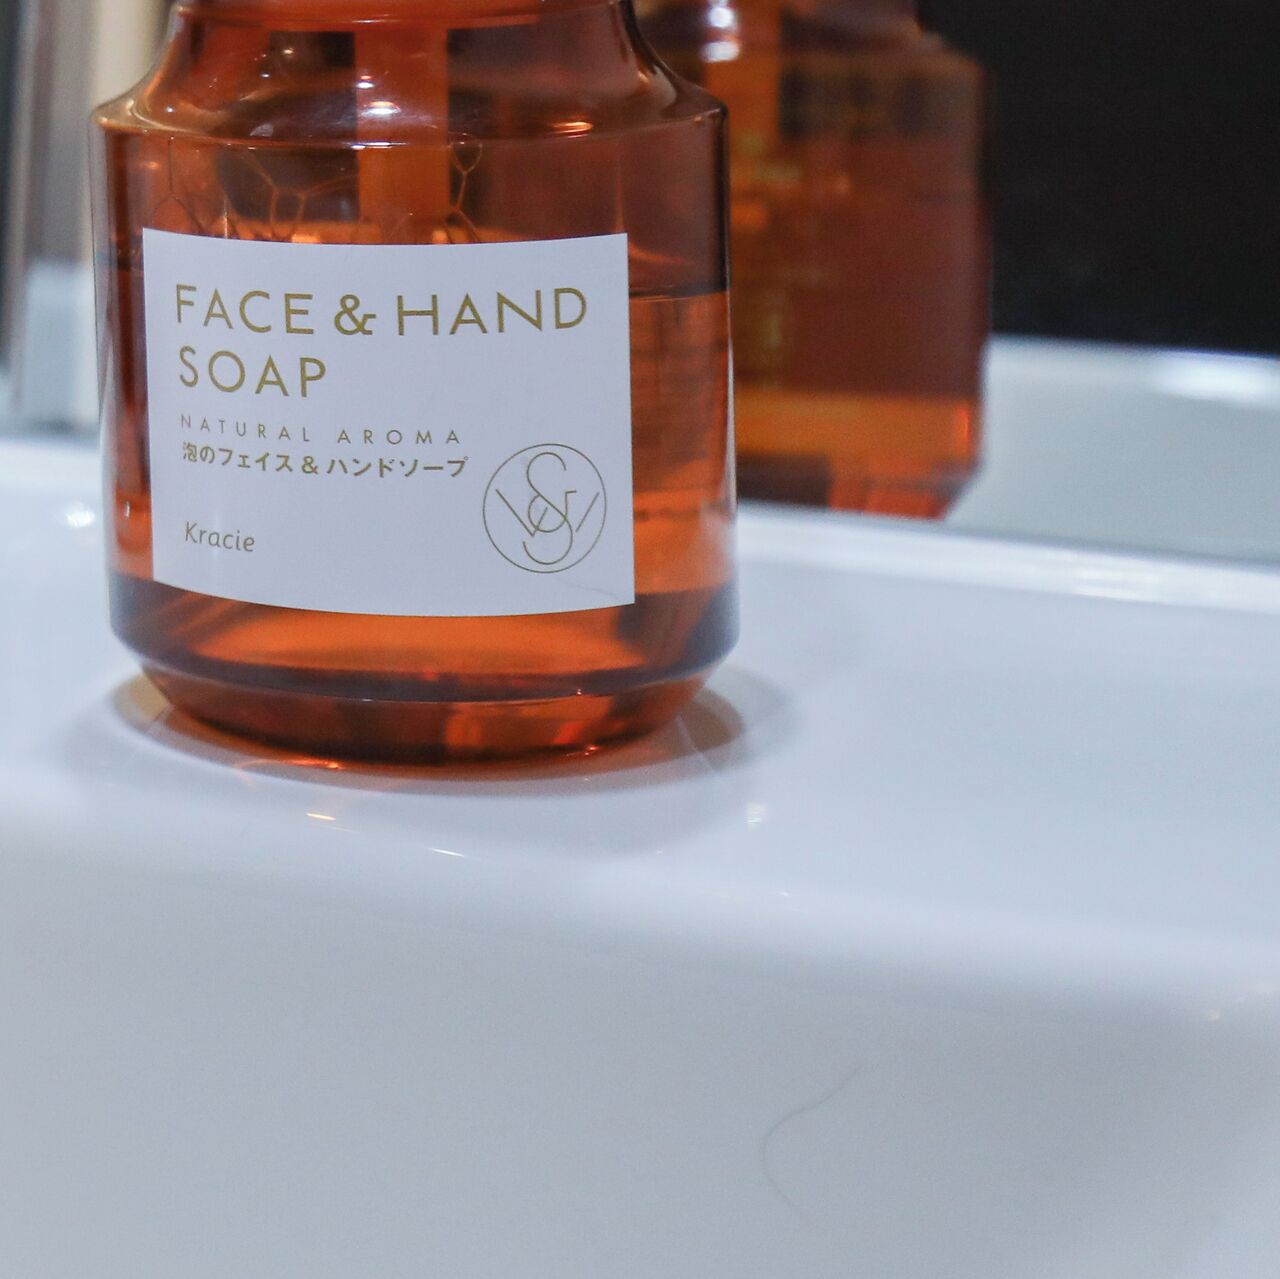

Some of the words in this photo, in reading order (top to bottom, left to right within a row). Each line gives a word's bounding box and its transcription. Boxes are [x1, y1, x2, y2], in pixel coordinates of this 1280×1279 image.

[175, 283, 316, 335] FACE
[332, 293, 378, 336] &
[395, 287, 589, 337] HAND
[178, 345, 328, 399] SOAP
[180, 414, 311, 443] NATURAL
[336, 428, 460, 446] AROMA
[185, 521, 256, 553] Kracie
